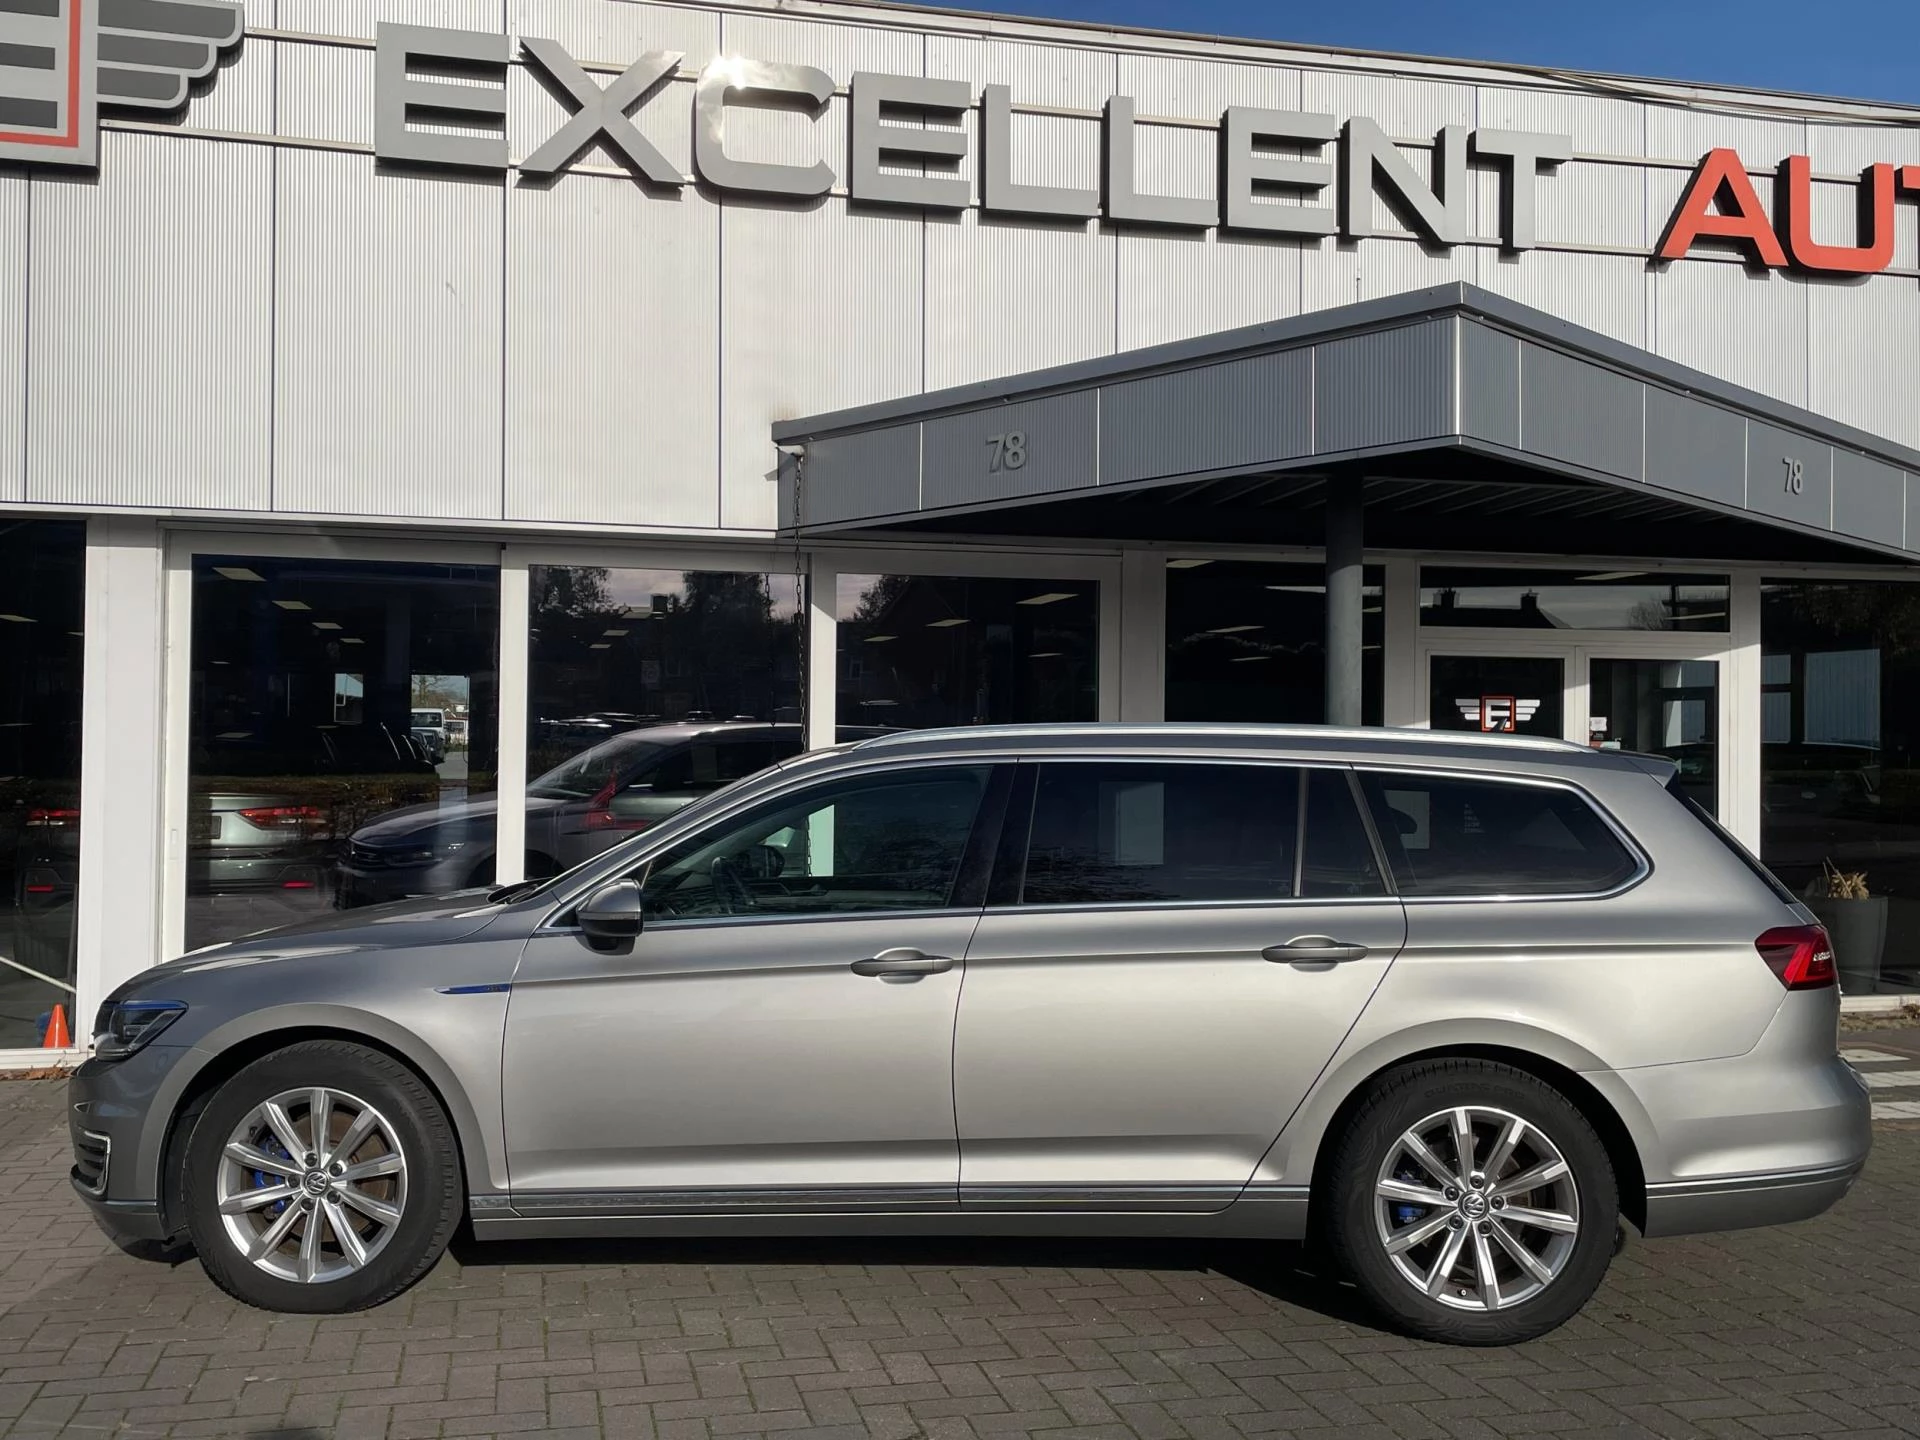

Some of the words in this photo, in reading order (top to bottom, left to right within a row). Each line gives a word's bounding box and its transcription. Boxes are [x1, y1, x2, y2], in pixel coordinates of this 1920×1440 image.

[376, 22, 1573, 249] EXCELLENT
[1657, 148, 1920, 272] AU
[986, 431, 1026, 473] 78
[1783, 456, 1803, 495] 78
